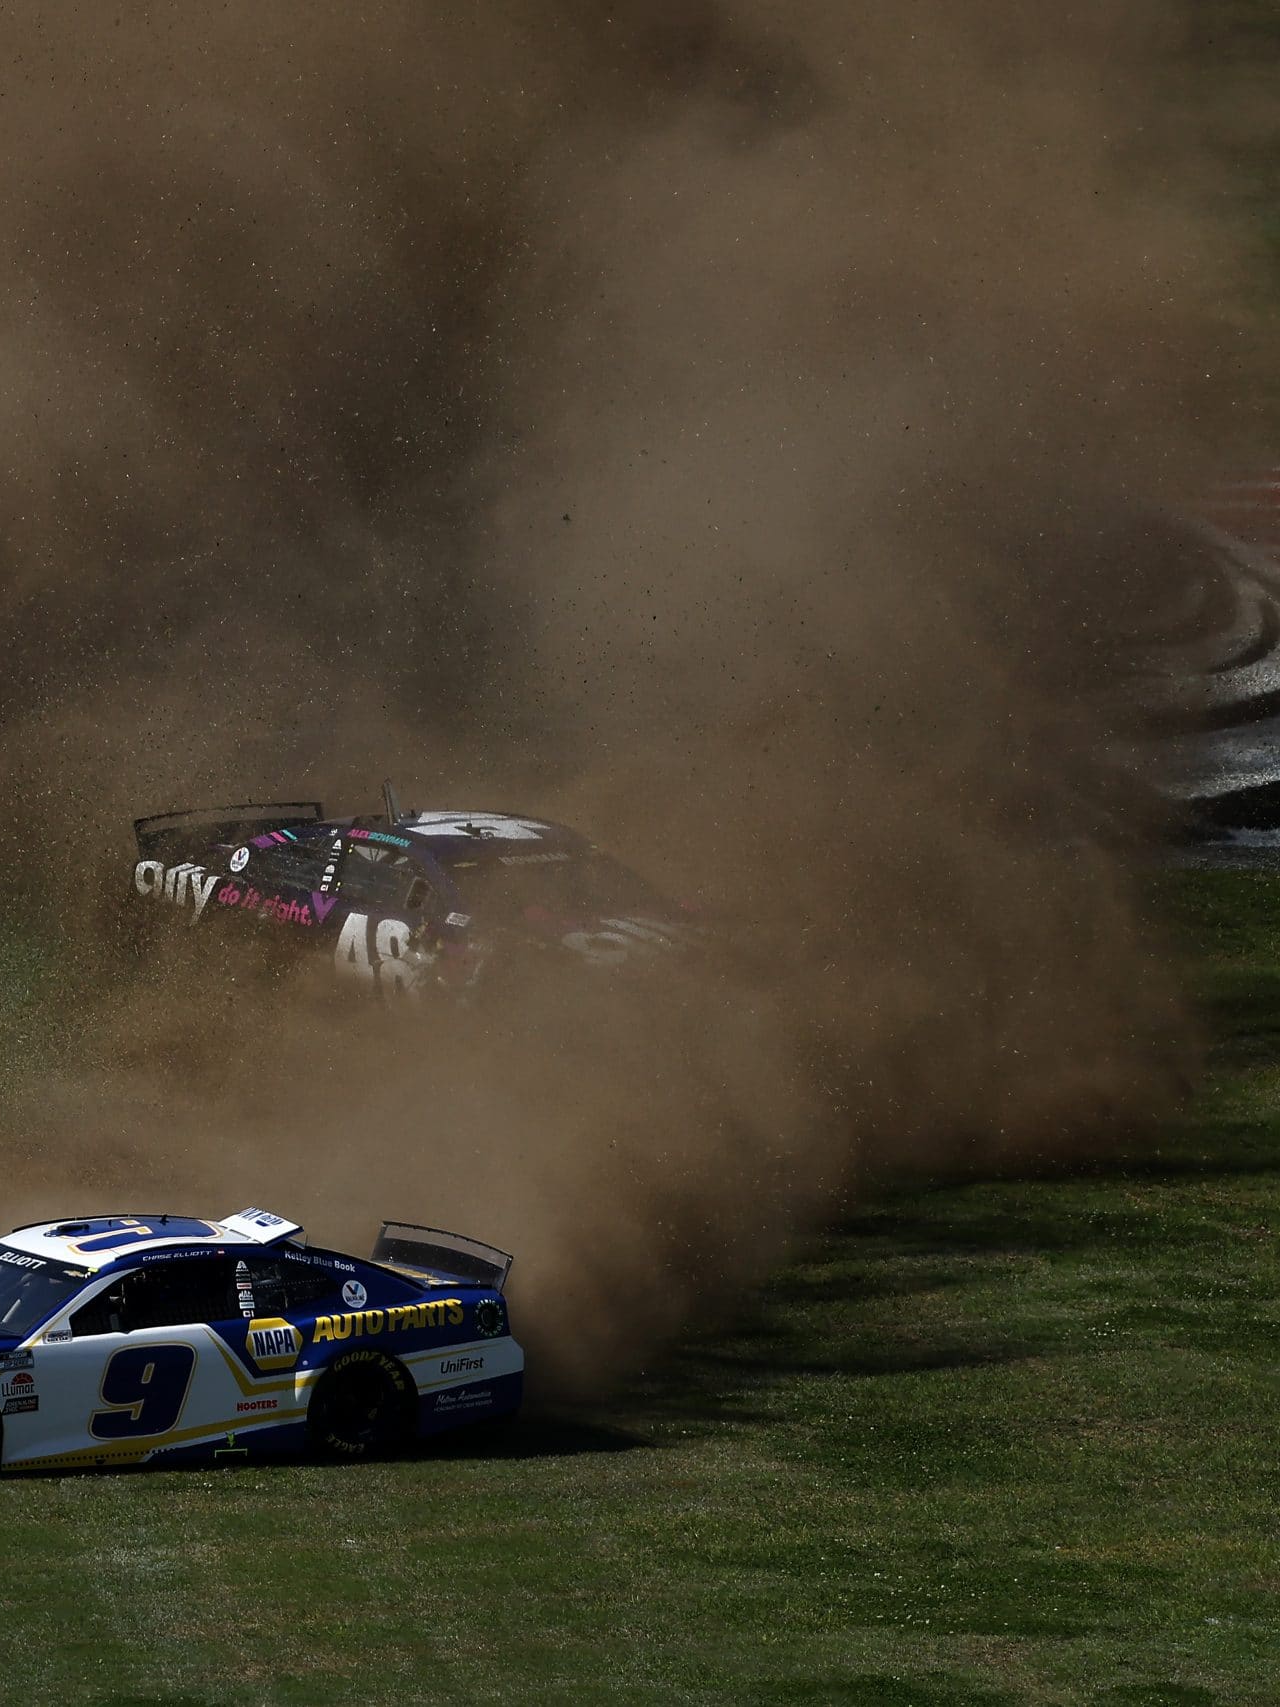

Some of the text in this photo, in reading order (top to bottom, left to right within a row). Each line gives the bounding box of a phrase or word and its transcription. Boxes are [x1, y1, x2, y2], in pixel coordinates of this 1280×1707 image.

[219, 881, 241, 905] do
[334, 912, 416, 1000] 48
[143, 1250, 213, 1262] CHASE ELLIOTT
[284, 1250, 356, 1273] Kelley Blue Book
[312, 1298, 465, 1343] AUTO PARTS
[252, 1328, 296, 1357] NAPA
[440, 1357, 485, 1375] UniFirst
[89, 1341, 199, 1441] 9
[236, 1400, 278, 1412] HOOTERS
